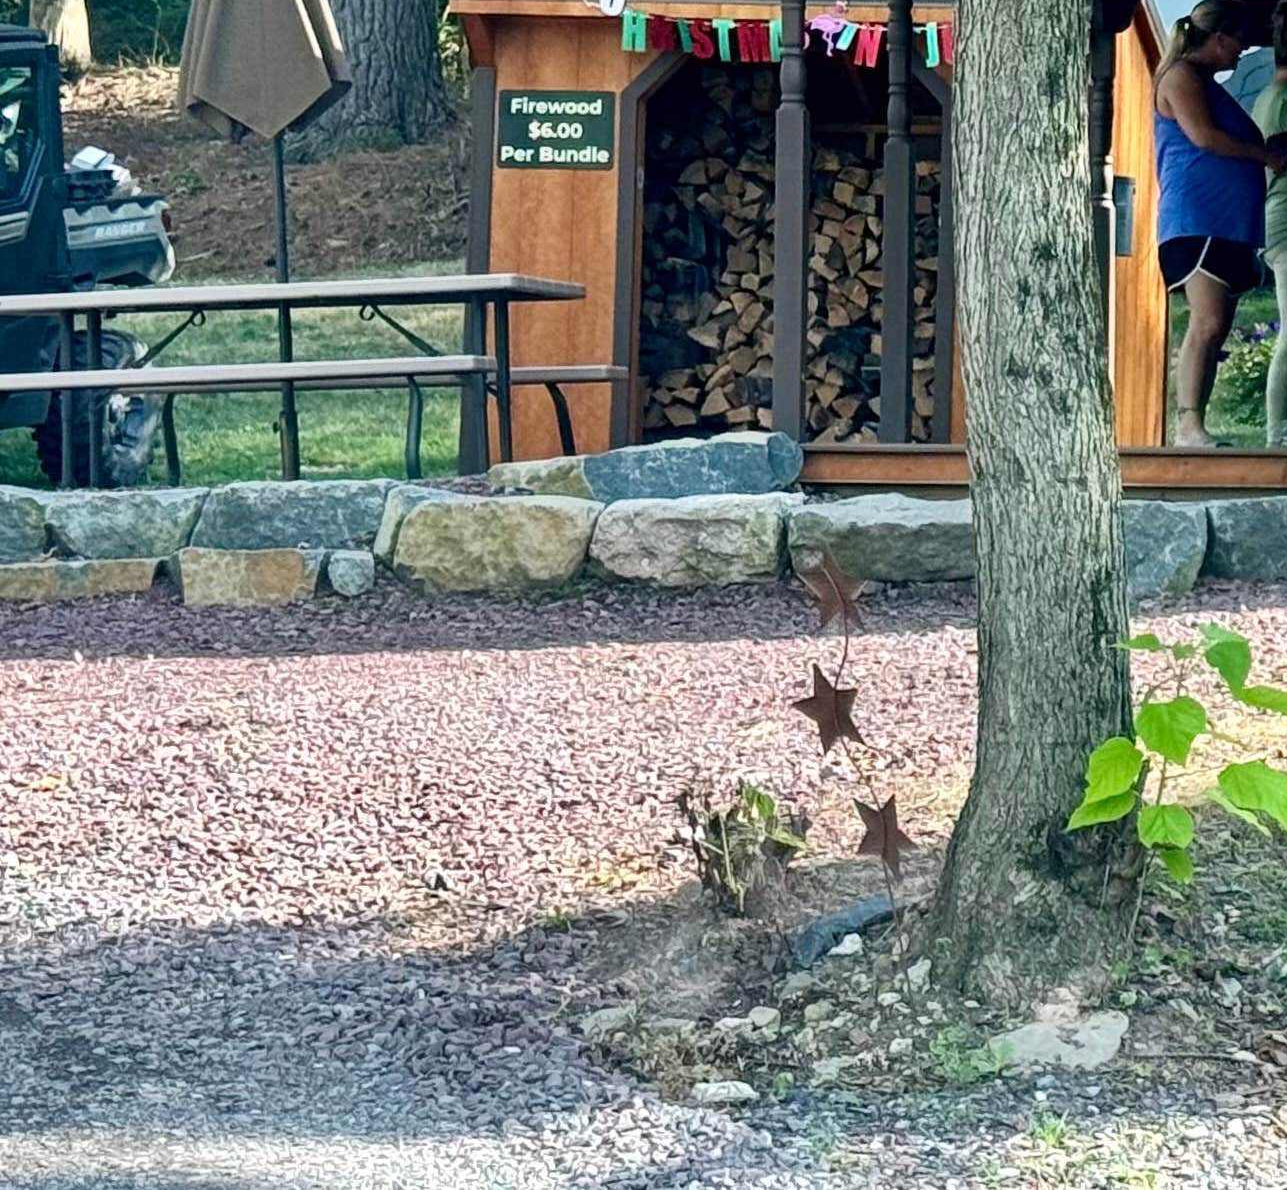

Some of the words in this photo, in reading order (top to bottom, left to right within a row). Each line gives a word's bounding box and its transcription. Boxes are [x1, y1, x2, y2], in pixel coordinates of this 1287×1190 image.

[510, 96, 602, 115] Firewood
[528, 119, 584, 140] $6.00
[500, 145, 535, 162] Per
[538, 145, 610, 163] Bundle
